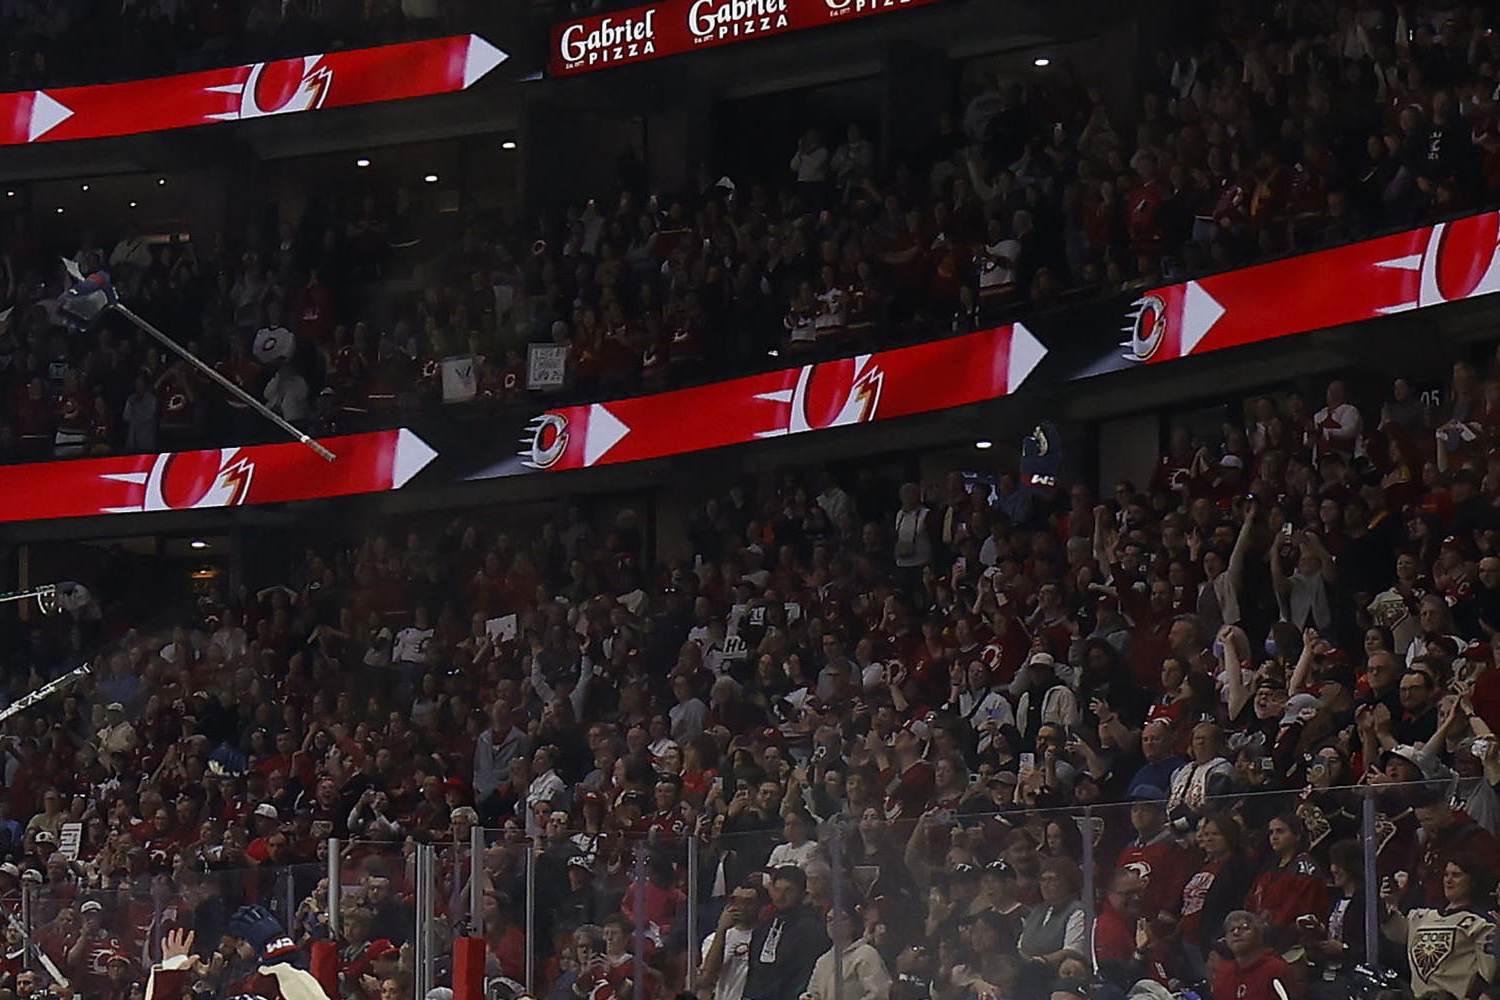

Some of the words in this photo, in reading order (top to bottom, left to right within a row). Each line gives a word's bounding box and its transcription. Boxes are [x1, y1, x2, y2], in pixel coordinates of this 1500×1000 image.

[561, 9, 656, 61] Gabriel
[718, 14, 788, 38] PIZZA
[589, 41, 655, 65] PIZZA
